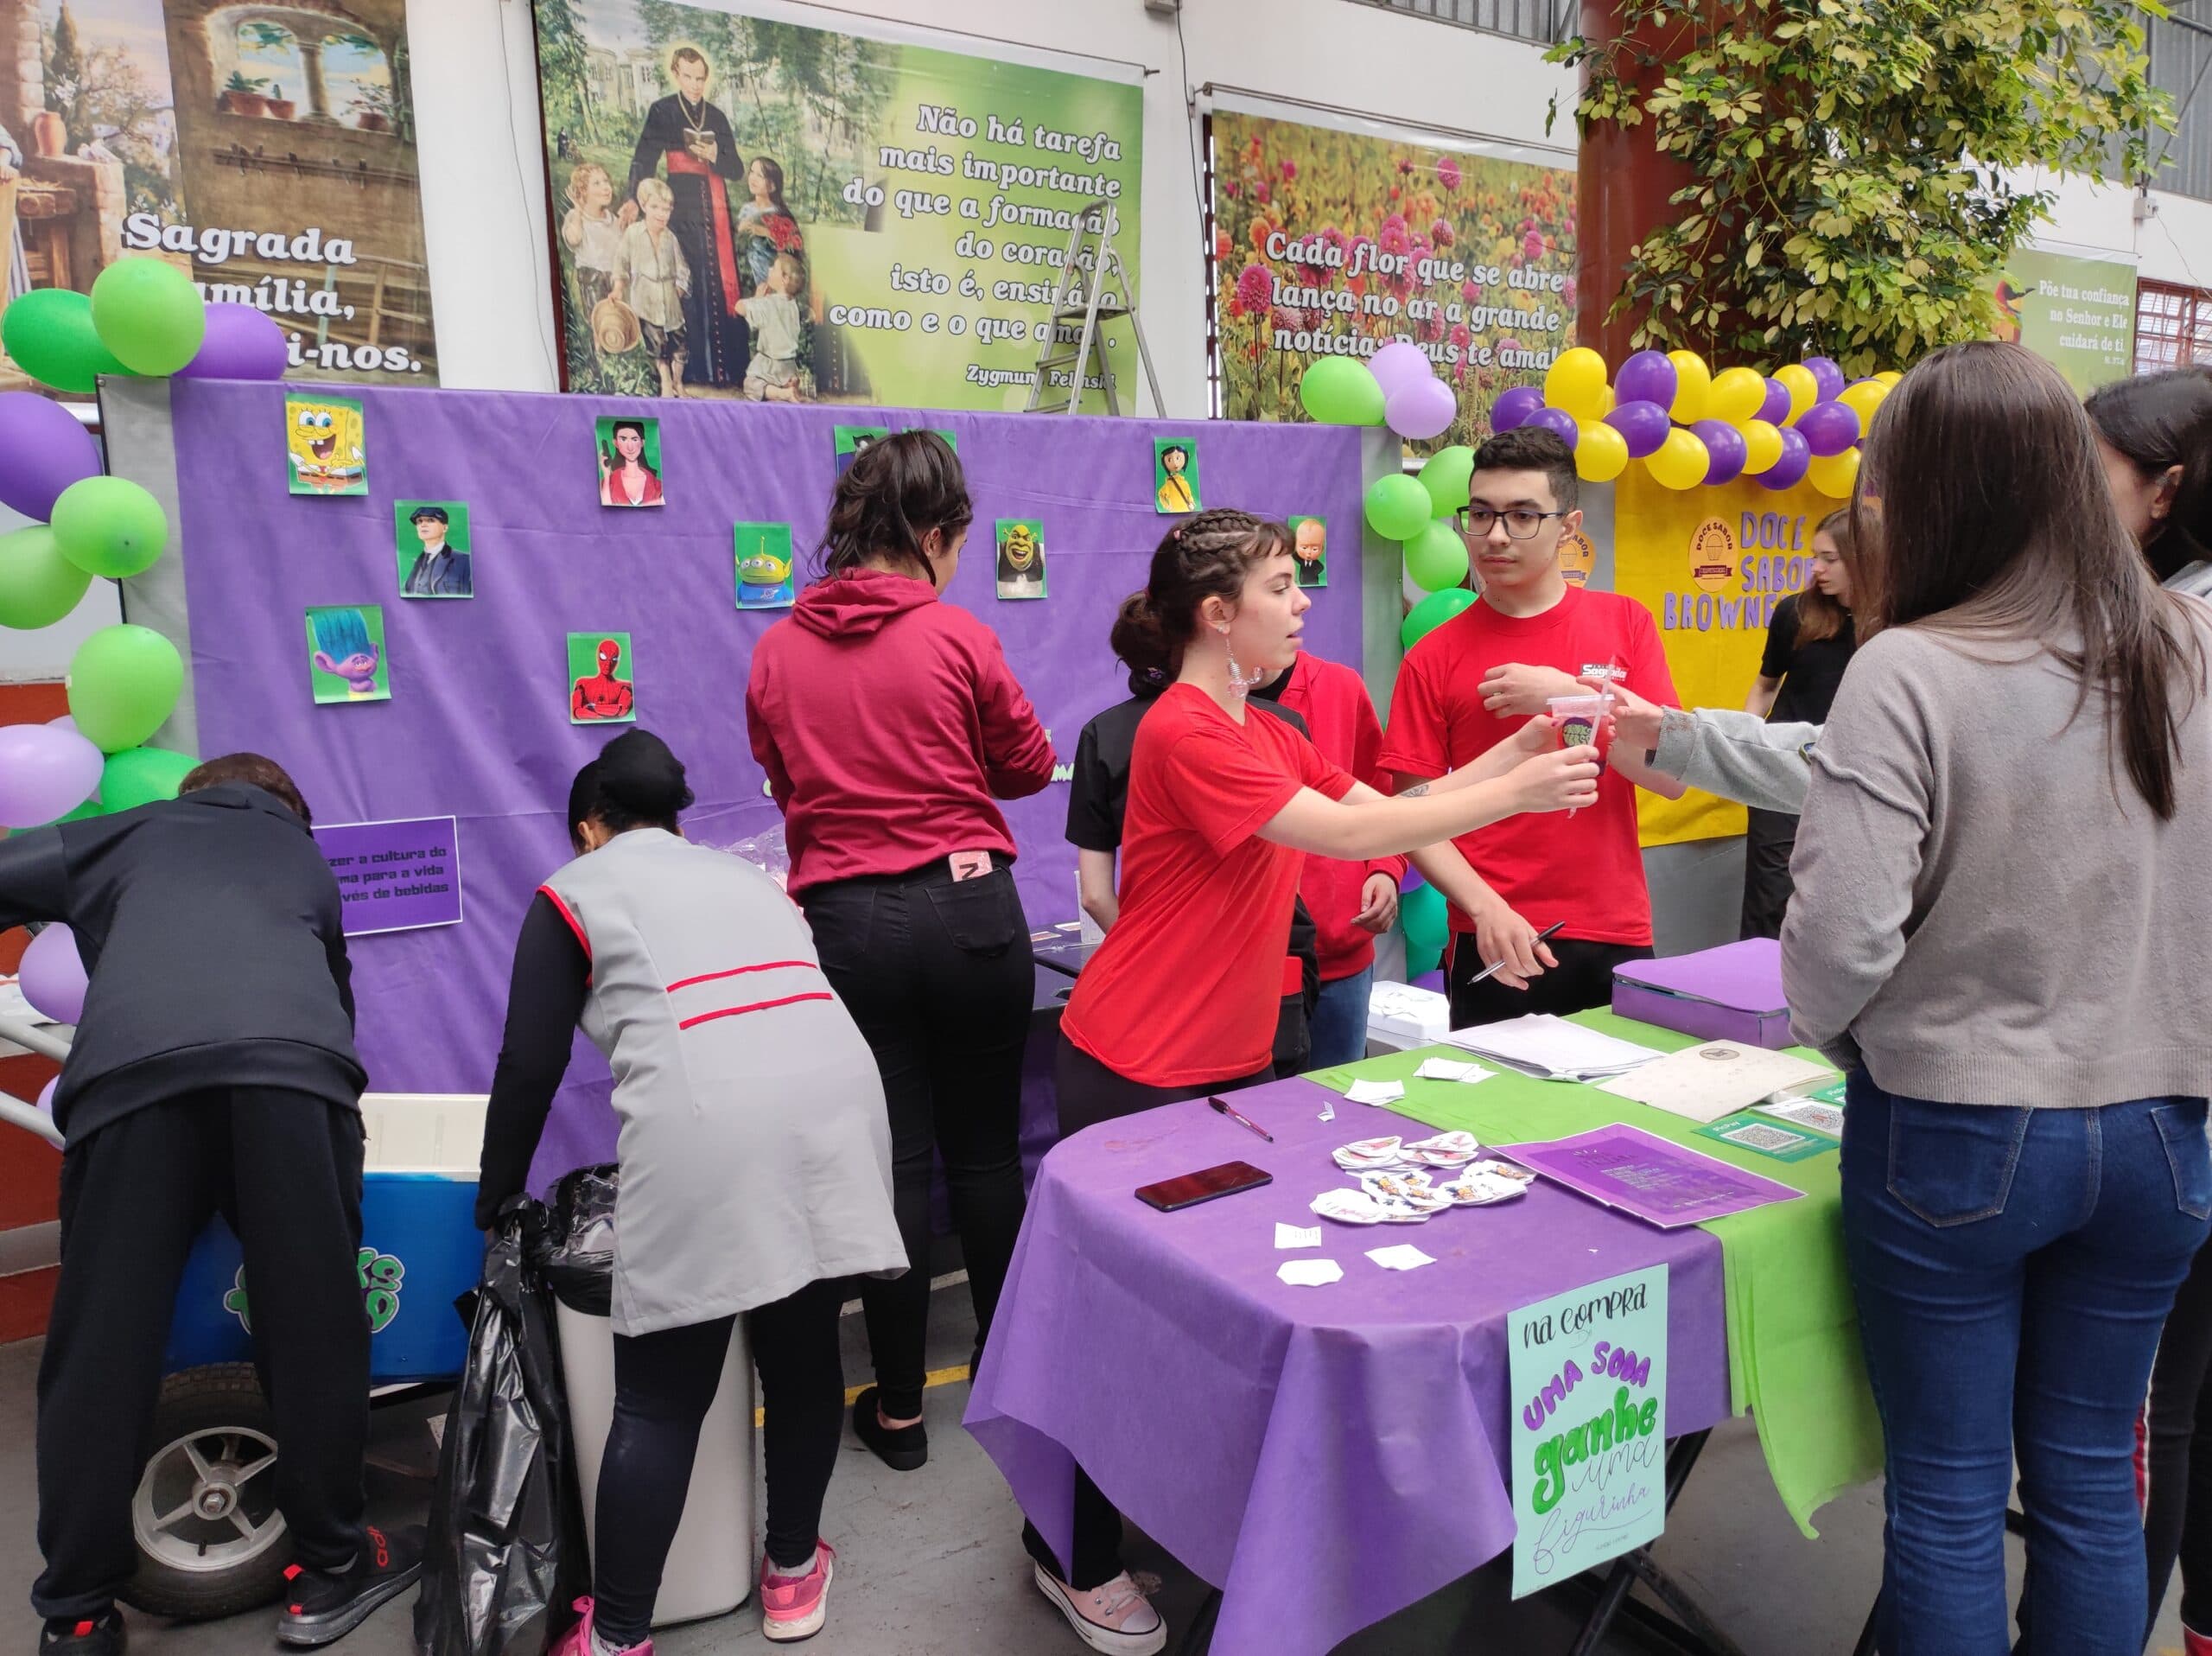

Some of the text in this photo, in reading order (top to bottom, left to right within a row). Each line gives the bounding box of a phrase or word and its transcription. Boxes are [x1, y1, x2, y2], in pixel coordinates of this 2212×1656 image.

[917, 105, 1122, 163] Não há tarefa
[879, 146, 1122, 199] mais importante
[842, 177, 885, 207] do
[894, 190, 950, 219] que
[959, 198, 980, 219] a
[125, 212, 357, 264] Sagrada
[955, 232, 994, 259] do
[1265, 231, 1564, 293] Cada flor que se abre
[891, 264, 950, 294] isto
[958, 271, 984, 301] é,
[2039, 280, 2130, 309] Põe tua confiança
[829, 304, 912, 331] como
[921, 313, 939, 334] e
[948, 315, 967, 335] o
[976, 317, 1027, 344] que
[1271, 277, 1560, 334] lança no ar a grande
[2050, 308, 2128, 329] no Senhor e Ele
[286, 332, 422, 372] i-nos.
[1467, 341, 1492, 366] te
[2059, 333, 2099, 350] cuidará
[2101, 336, 2113, 351] de
[966, 364, 1038, 390] Zygmun
[1741, 512, 1806, 551] DOCE
[359, 856, 367, 864] a
[372, 850, 425, 863] cultura
[429, 847, 447, 857] do
[363, 870, 397, 885] para
[401, 869, 410, 878] a
[414, 864, 443, 876] vida
[373, 889, 390, 899] de
[394, 883, 449, 897] bebidas
[1523, 1341, 1651, 1430] UMA SODA
[1532, 1385, 1657, 1515] ganhe
[1572, 1436, 1657, 1492] uma
